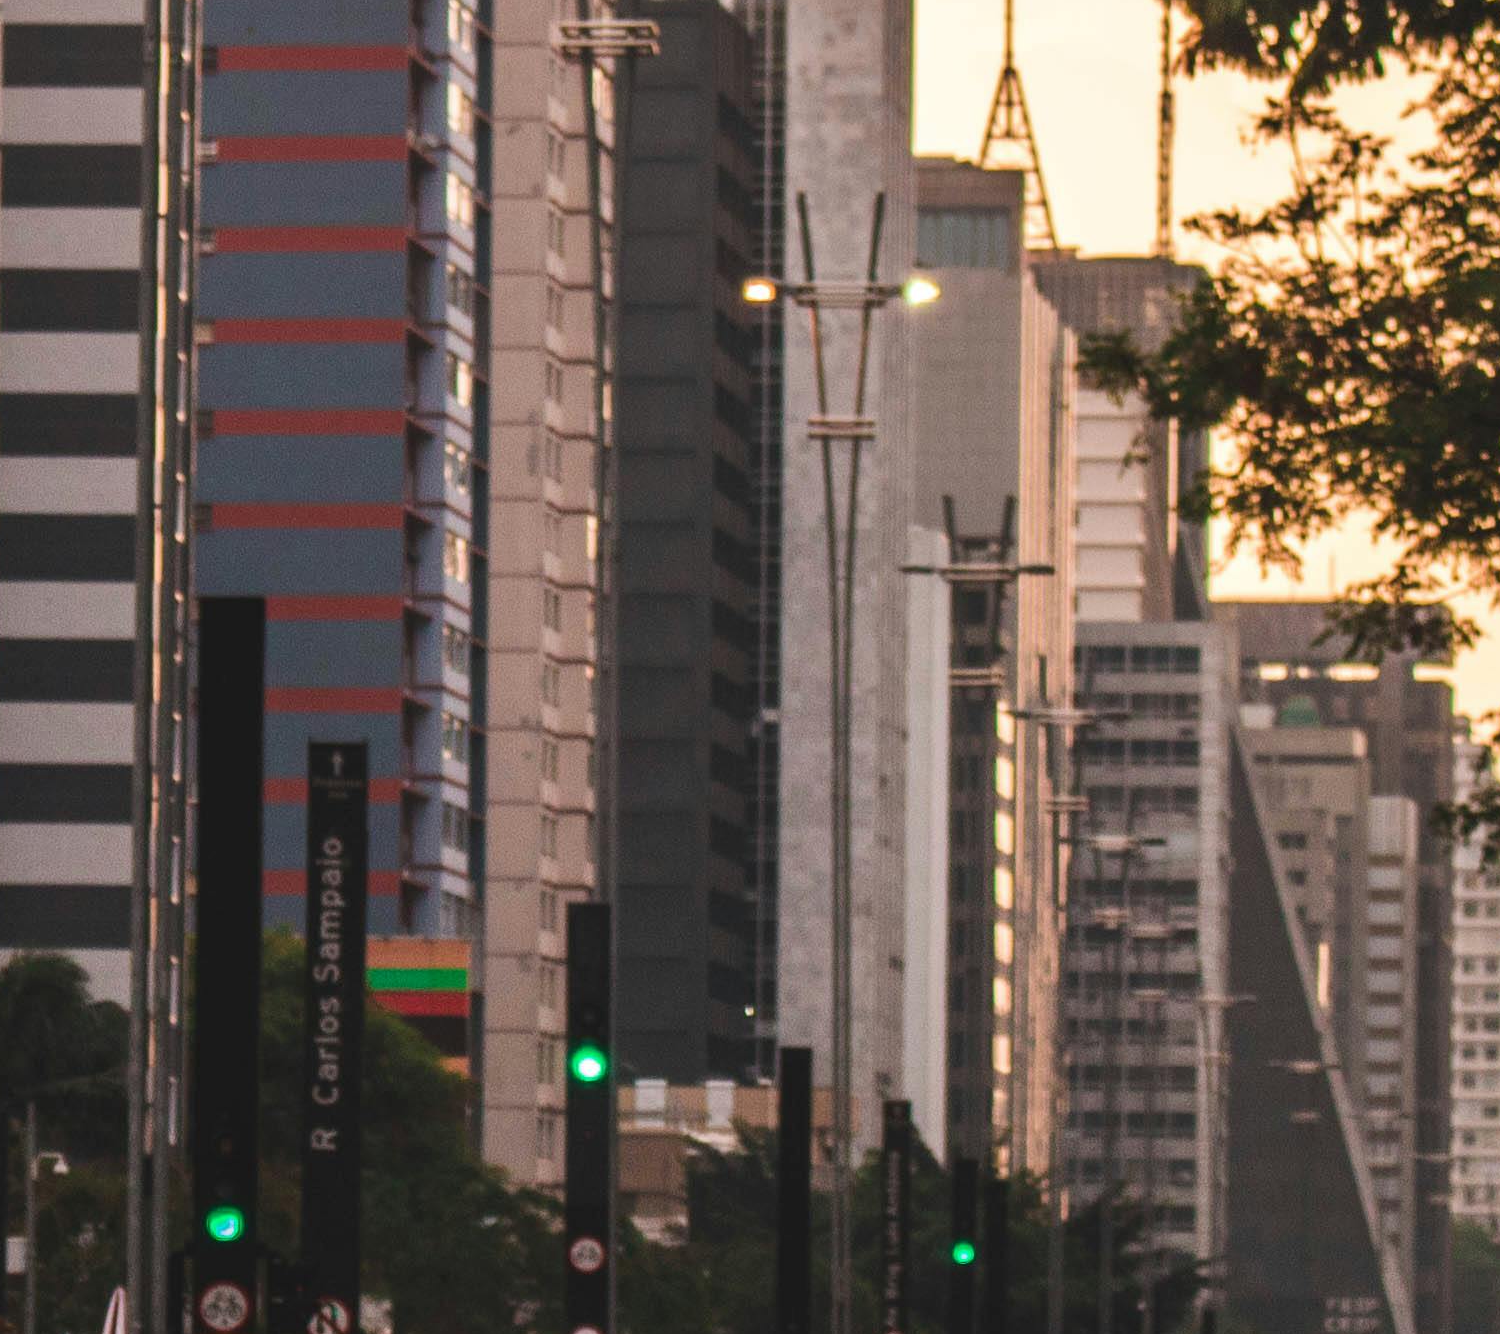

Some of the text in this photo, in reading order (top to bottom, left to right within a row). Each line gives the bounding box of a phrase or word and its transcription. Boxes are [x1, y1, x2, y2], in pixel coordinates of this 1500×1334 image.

[311, 836, 347, 985] Sampaio
[310, 996, 342, 1106] Carlos
[310, 1128, 338, 1152] R
